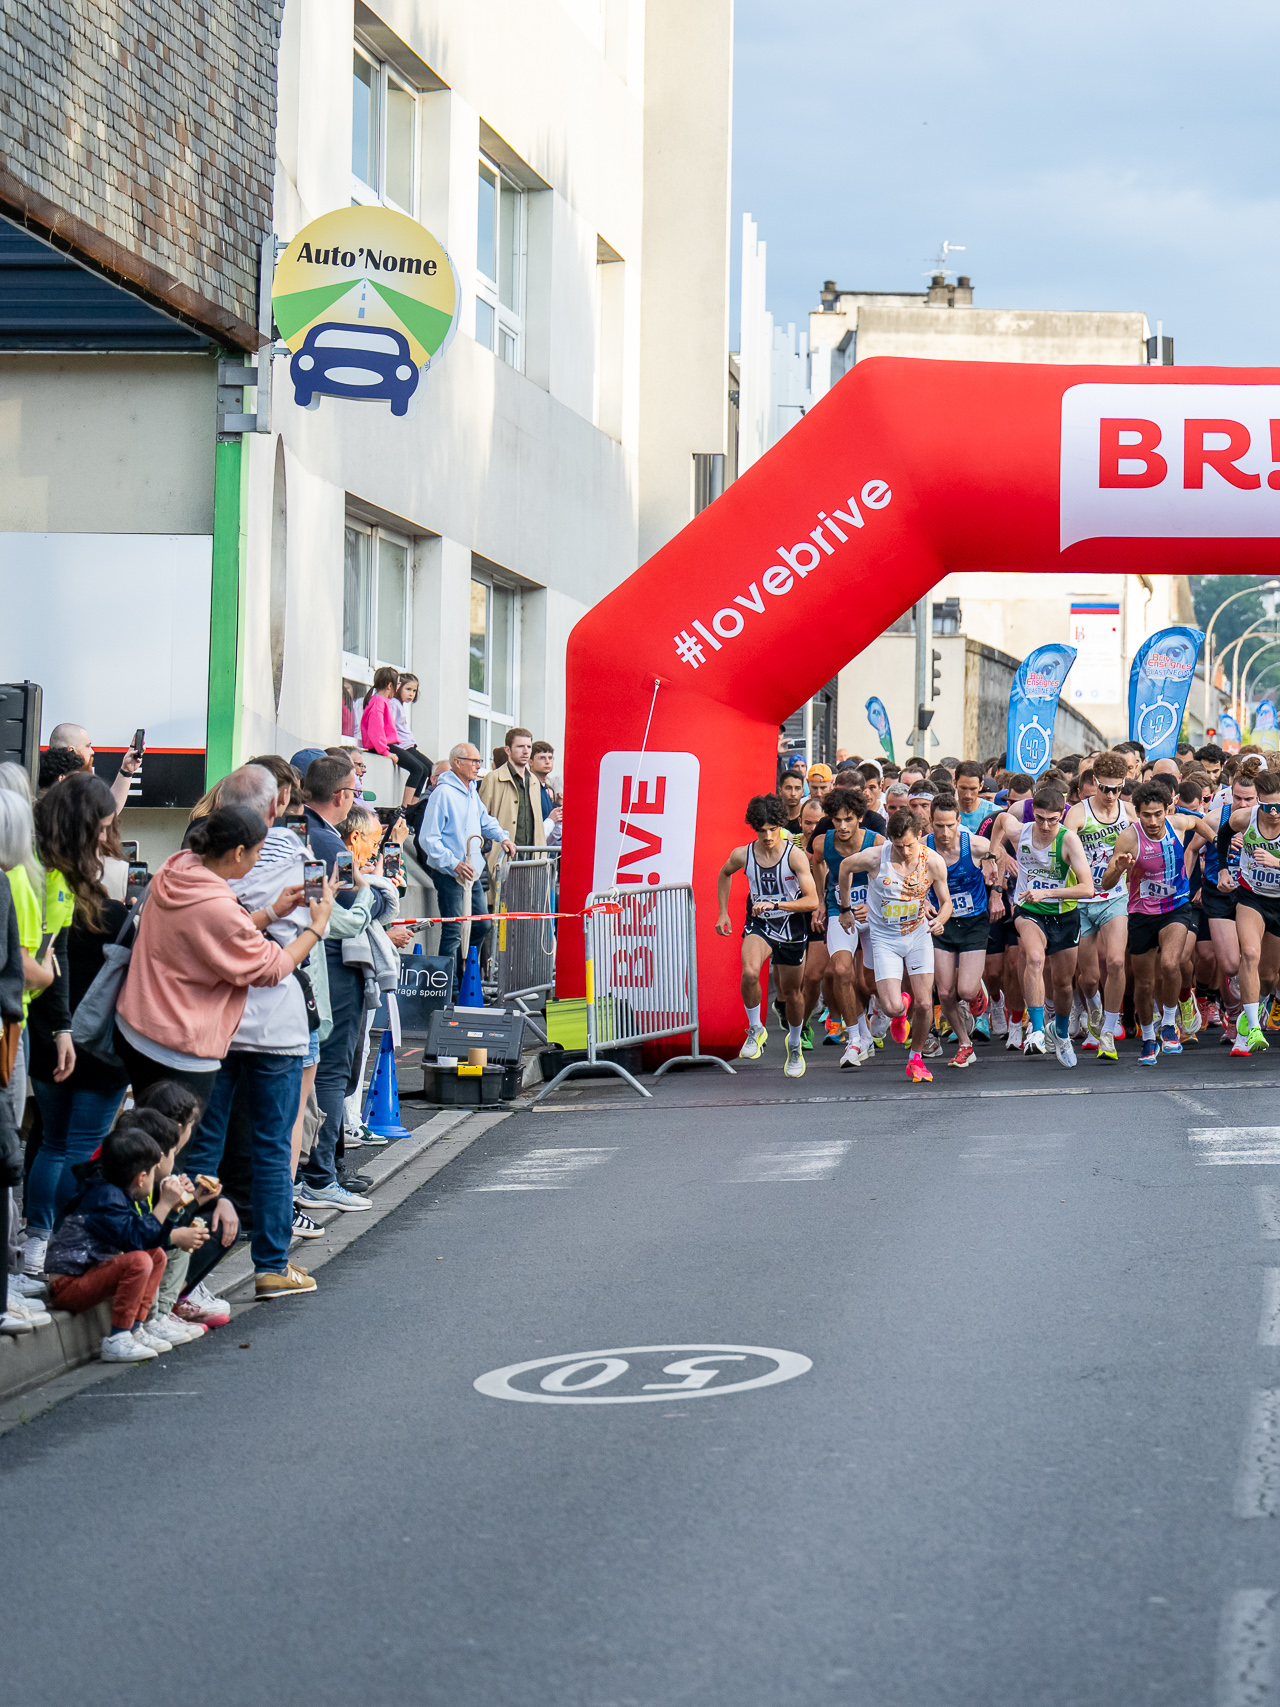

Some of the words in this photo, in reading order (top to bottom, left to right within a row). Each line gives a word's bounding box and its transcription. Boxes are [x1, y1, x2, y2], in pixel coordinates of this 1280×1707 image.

[296, 242, 438, 276] Auto'Nome
[673, 479, 892, 669] #lovebrive
[1026, 739, 1039, 759] 40
[1148, 882, 1168, 895] 471
[883, 903, 917, 917] 3379
[400, 962, 449, 988] ime
[419, 989, 448, 998] sportif
[539, 1354, 747, 1393] 50
